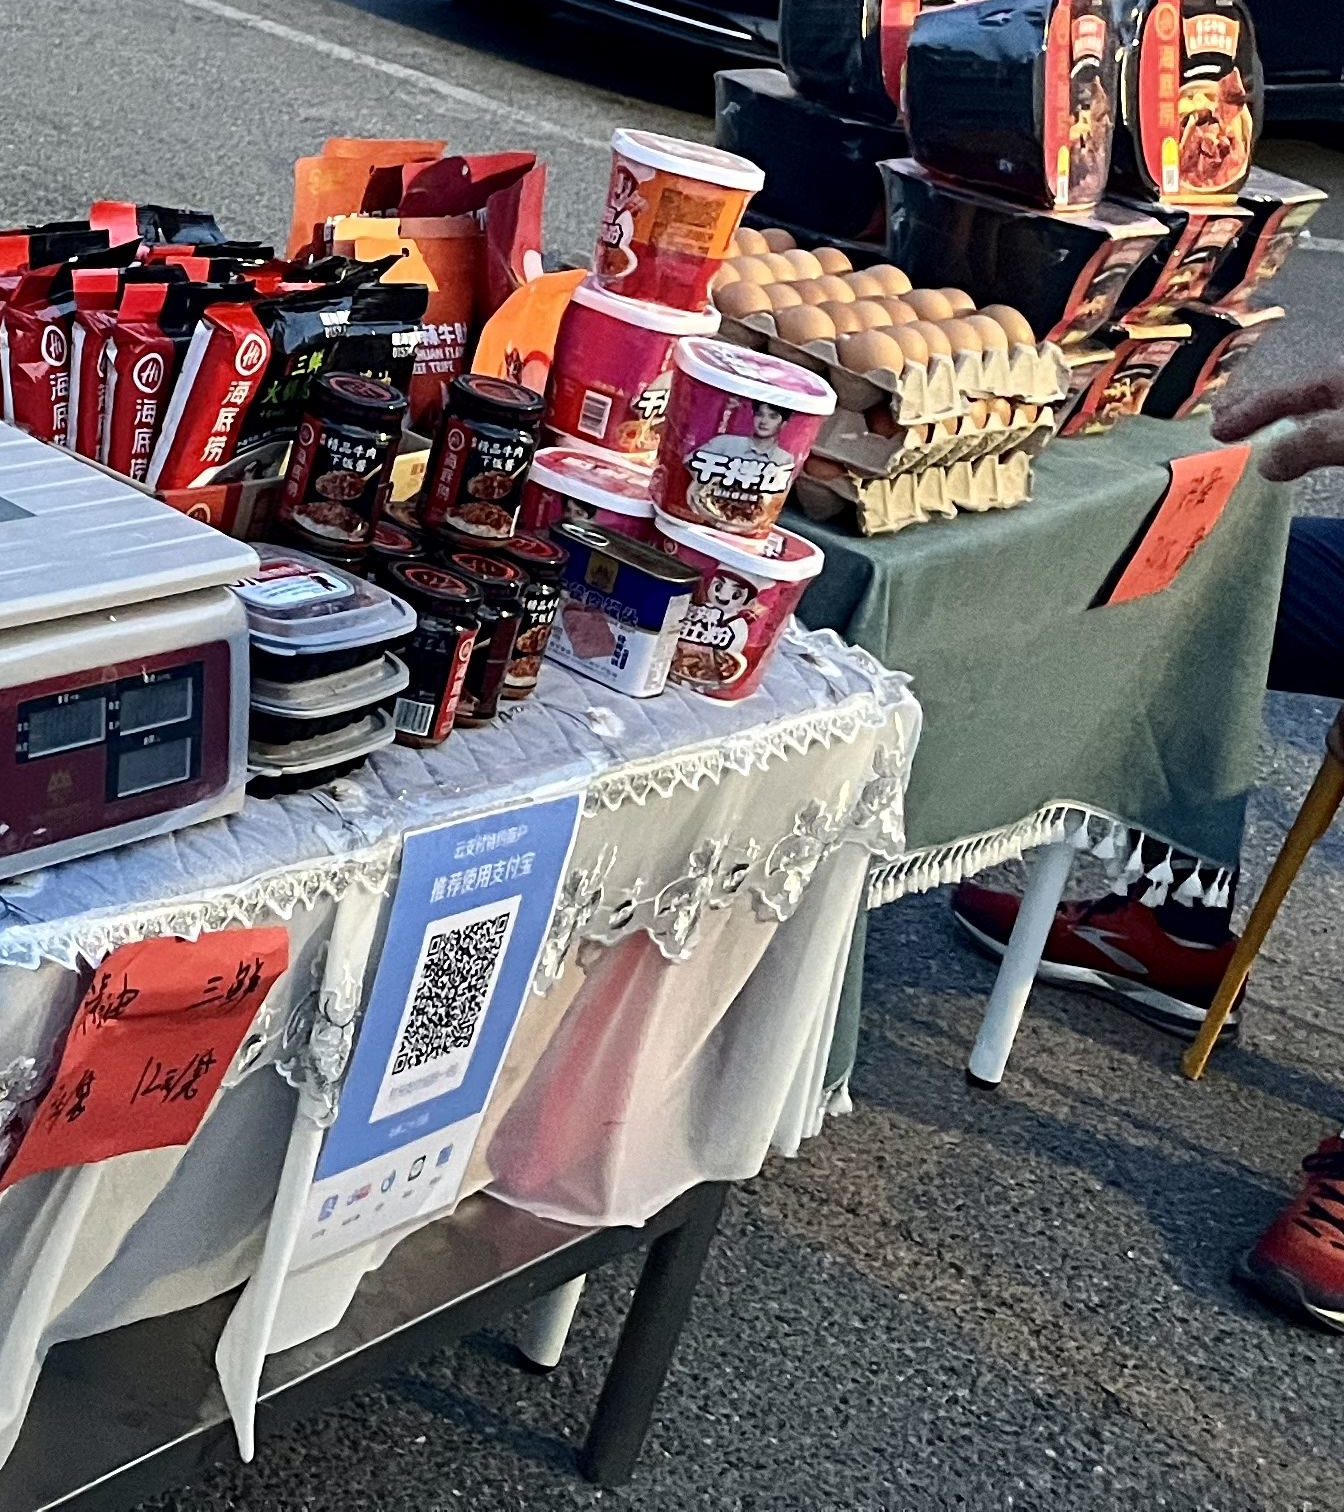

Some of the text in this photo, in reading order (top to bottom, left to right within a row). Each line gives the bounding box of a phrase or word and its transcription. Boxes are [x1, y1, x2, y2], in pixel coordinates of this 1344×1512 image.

[199, 380, 254, 463] 海底捞
[691, 451, 796, 492] 干拌饭
[430, 852, 536, 904] 推荐使用支付宝
